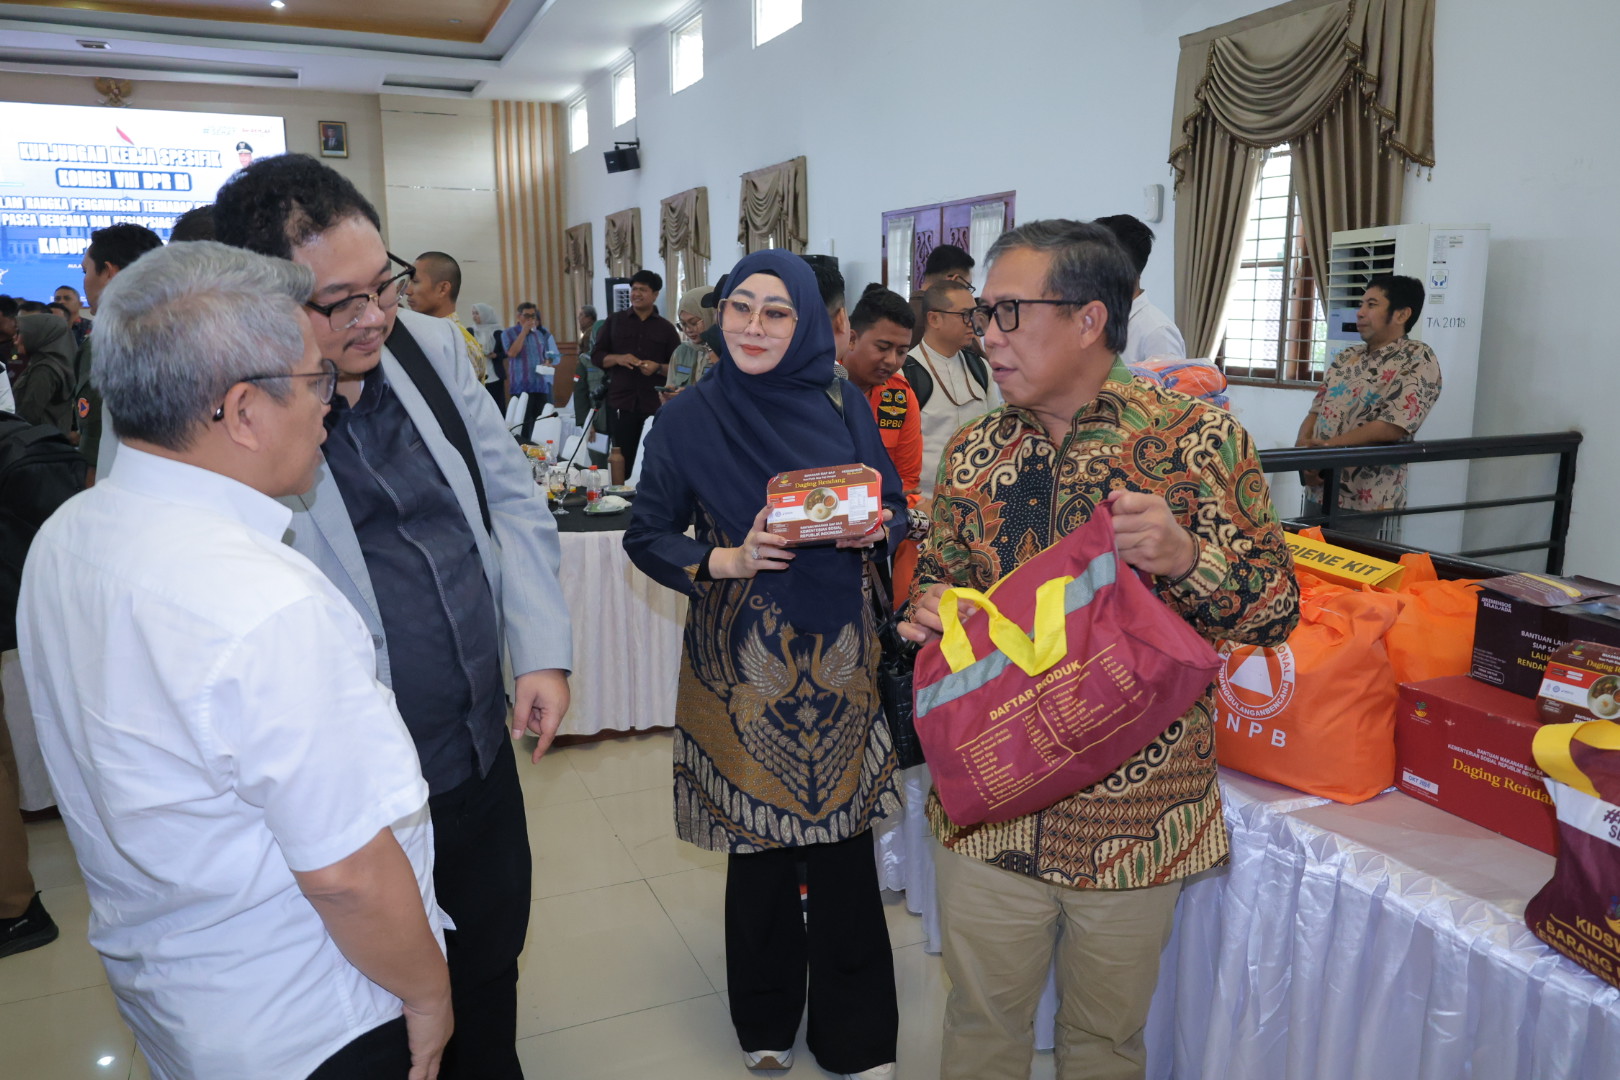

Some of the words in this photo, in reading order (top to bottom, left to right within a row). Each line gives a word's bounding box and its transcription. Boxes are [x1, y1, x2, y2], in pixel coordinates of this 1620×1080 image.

[18, 142, 108, 163] KUNJUNGAN
[110, 146, 158, 165] KERJA
[159, 148, 222, 168] SPESIFIK
[58, 169, 112, 188] KOMISI
[114, 171, 140, 189] VIII
[142, 172, 172, 190] DPR
[174, 173, 190, 190] RI
[26, 196, 70, 211] RANGKA
[70, 197, 142, 213] PENGAWASAN
[1, 213, 39, 227] PASCA
[39, 213, 89, 228] BENCANA
[1427, 317, 1440, 328] TA
[1442, 316, 1466, 328] 2018
[880, 418, 903, 428] BPBD
[818, 477, 846, 486] Rendang
[1341, 560, 1382, 576] KIT
[1521, 630, 1552, 644] BANTUAN
[1532, 642, 1546, 650] SIAP
[1587, 659, 1614, 673] Daging
[989, 688, 1036, 721] DAFTAR
[1447, 743, 1480, 759] KEMENTERIAN
[1481, 755, 1497, 766] SOSIAL
[1452, 758, 1501, 788] Daging
[1546, 920, 1613, 973] BARANG
